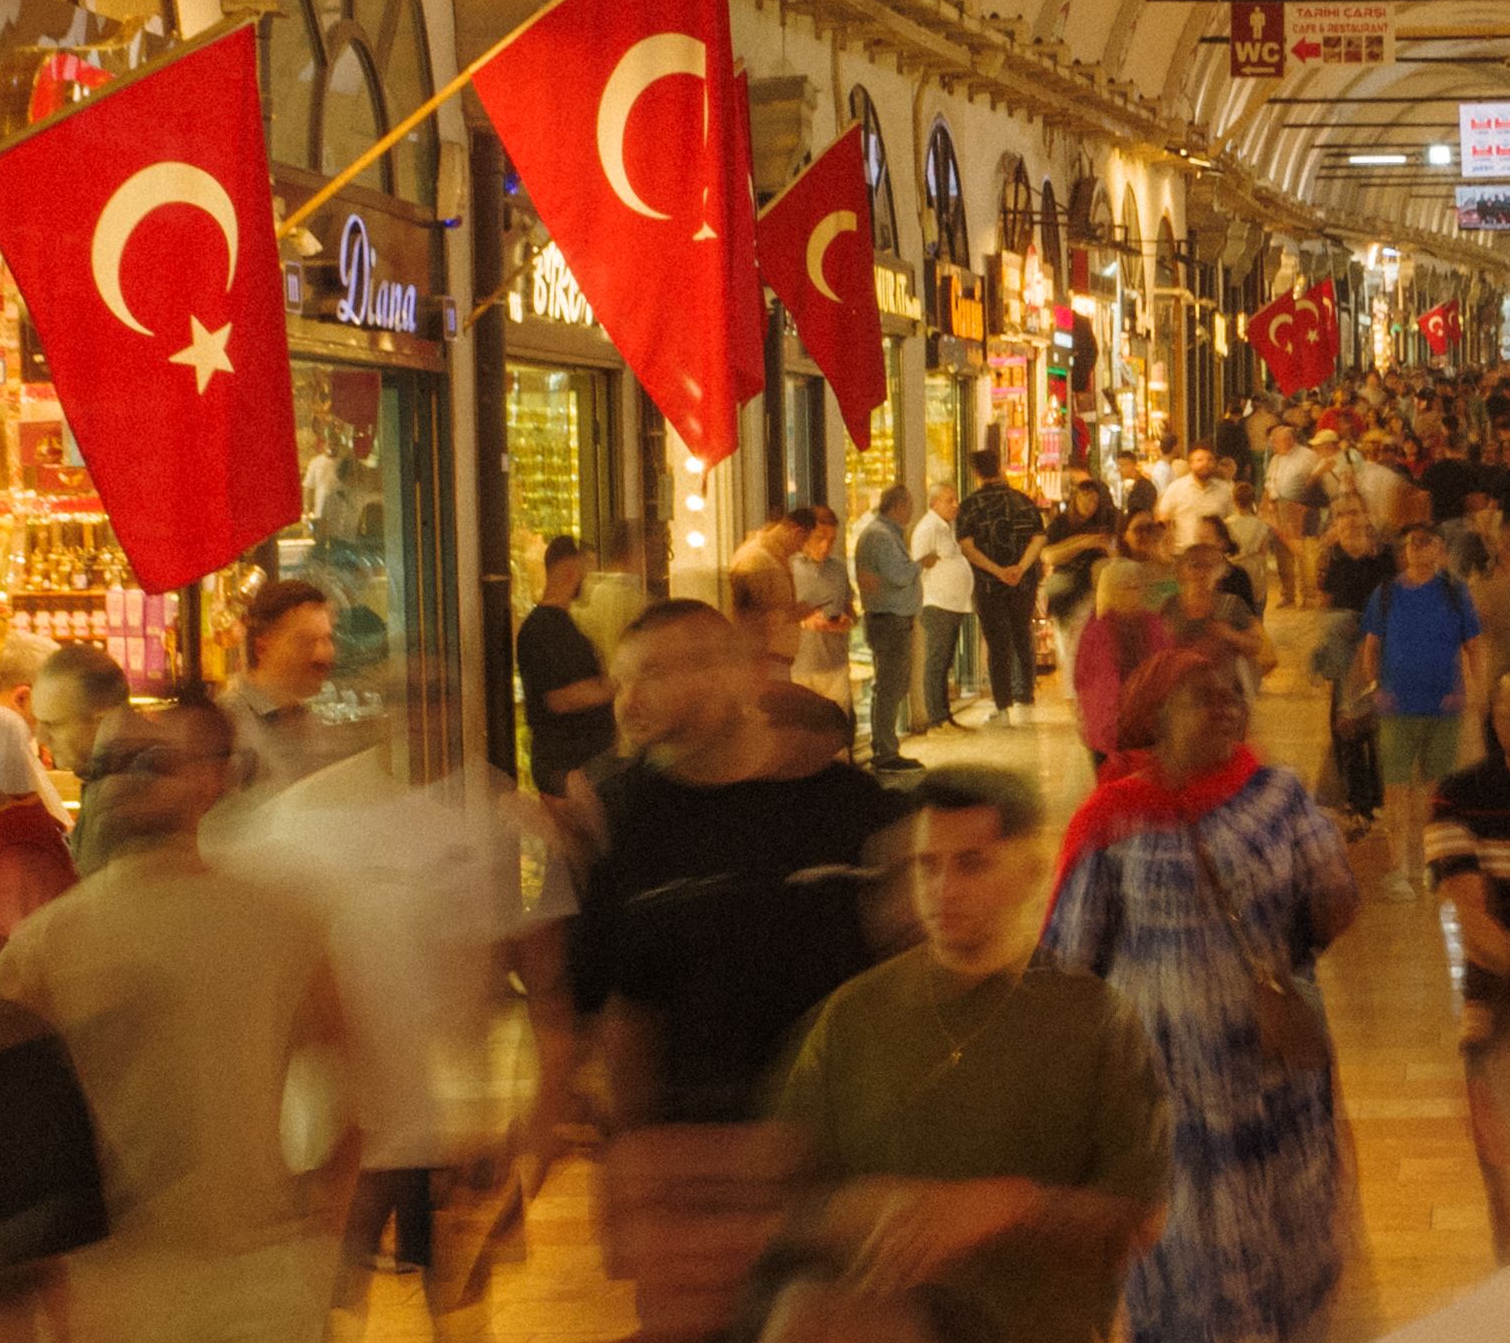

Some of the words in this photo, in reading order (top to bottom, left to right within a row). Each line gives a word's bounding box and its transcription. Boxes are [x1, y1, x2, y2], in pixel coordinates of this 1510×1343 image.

[1292, 24, 1316, 34] CAFE
[1326, 23, 1389, 34] RESTAURANT
[1235, 41, 1281, 63] WC
[336, 213, 418, 334] Diana
